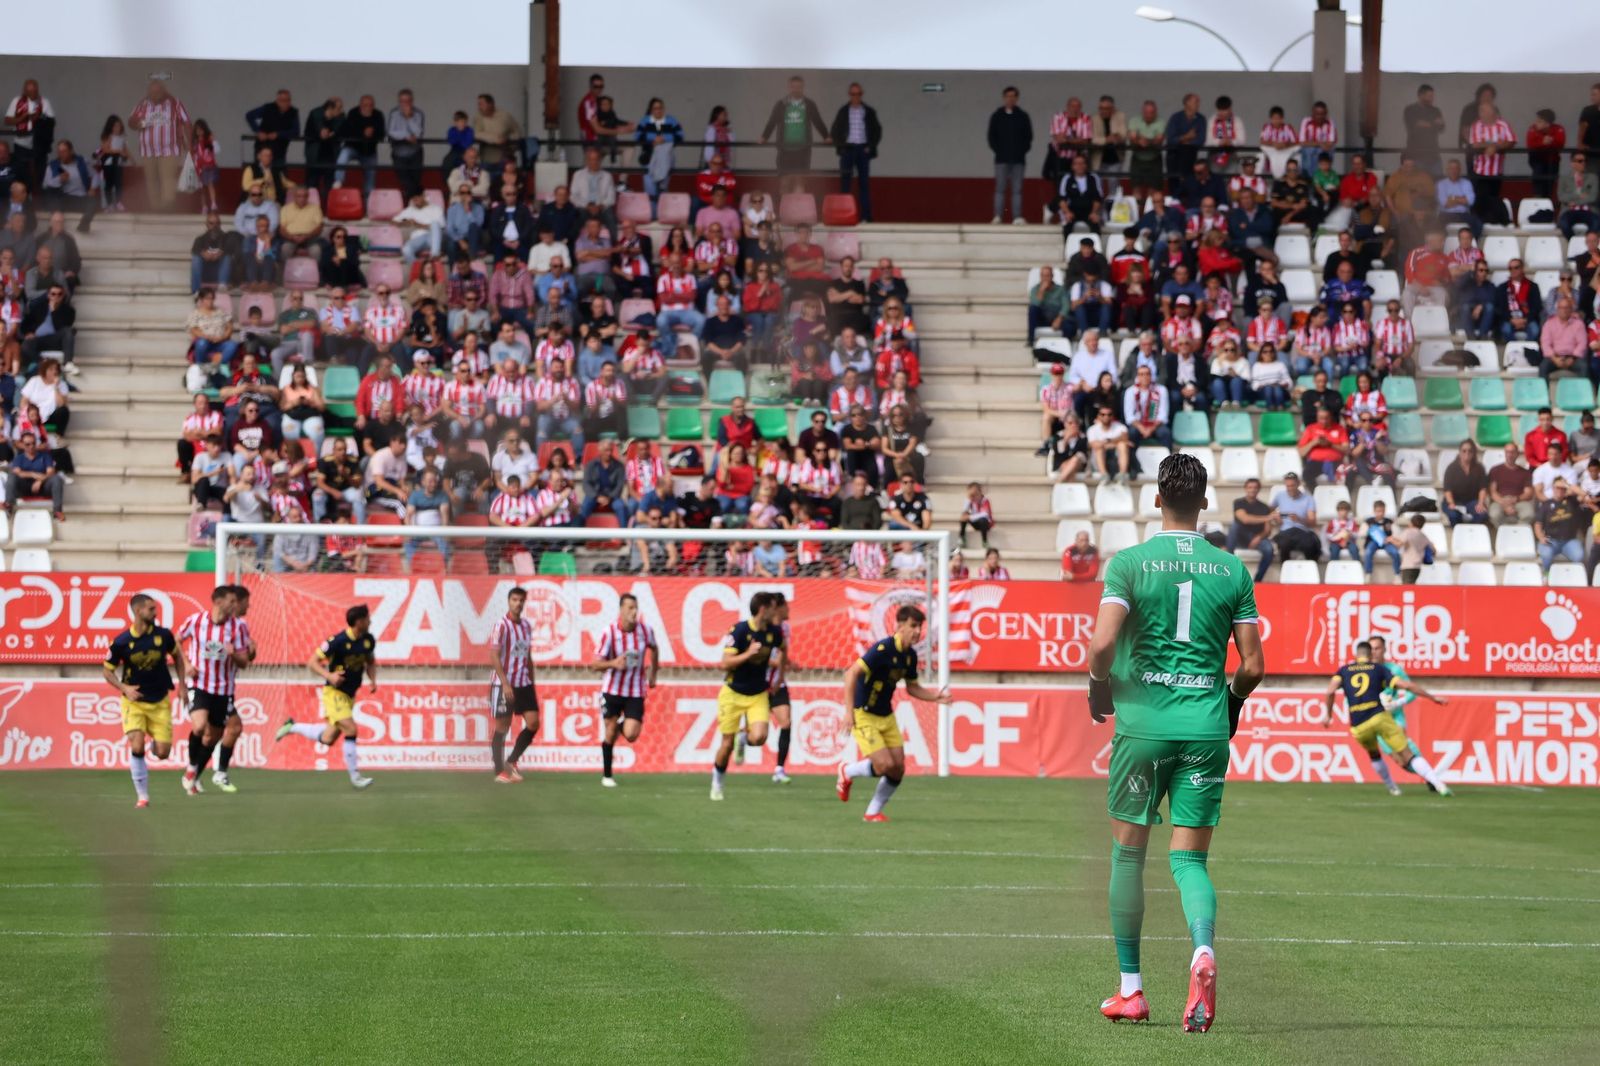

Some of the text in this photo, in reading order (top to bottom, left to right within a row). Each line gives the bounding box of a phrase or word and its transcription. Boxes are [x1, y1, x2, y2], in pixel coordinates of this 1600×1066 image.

[971, 612, 1095, 641] CENTR
[1173, 579, 1193, 643] 1
[1338, 590, 1452, 639] fisio
[4, 634, 35, 649] OS
[63, 634, 110, 649] JAM
[1037, 640, 1088, 668] RO
[1339, 629, 1470, 670] rdapt
[1485, 636, 1600, 672] podoact
[1350, 672, 1370, 698] 9
[1561, 663, 1569, 673] Y
[393, 691, 492, 713] bodegas
[1495, 701, 1600, 738] PERS
[946, 701, 1028, 768] CF
[1230, 743, 1364, 783] MORA
[1432, 739, 1600, 785] ZAMOR
